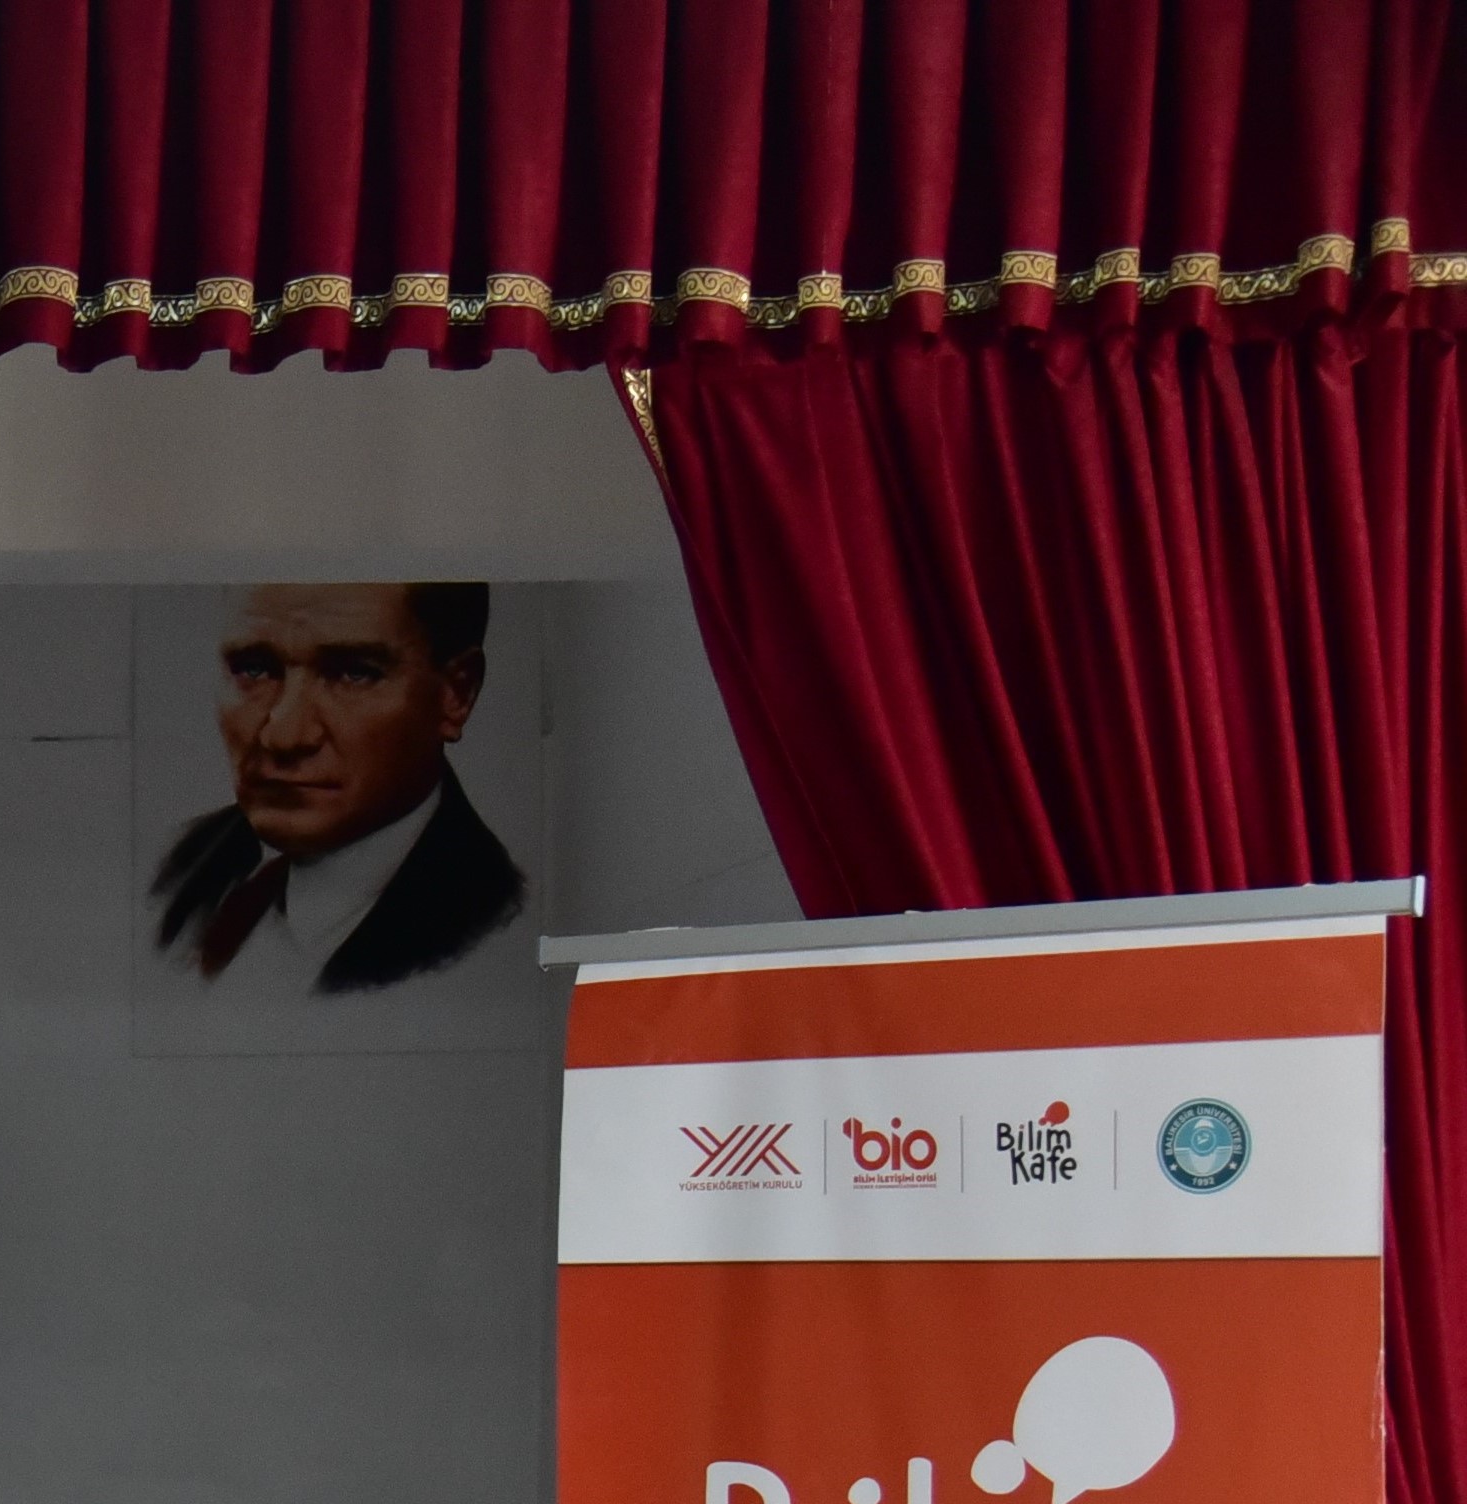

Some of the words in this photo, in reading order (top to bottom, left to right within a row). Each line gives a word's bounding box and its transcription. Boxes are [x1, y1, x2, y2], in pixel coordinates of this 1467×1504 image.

[842, 1117, 937, 1171] bio
[997, 1120, 1071, 1151] Bilim
[1011, 1146, 1077, 1185] Kafe
[762, 1179, 803, 1189] KURULU
[1192, 1177, 1215, 1186] 1992
